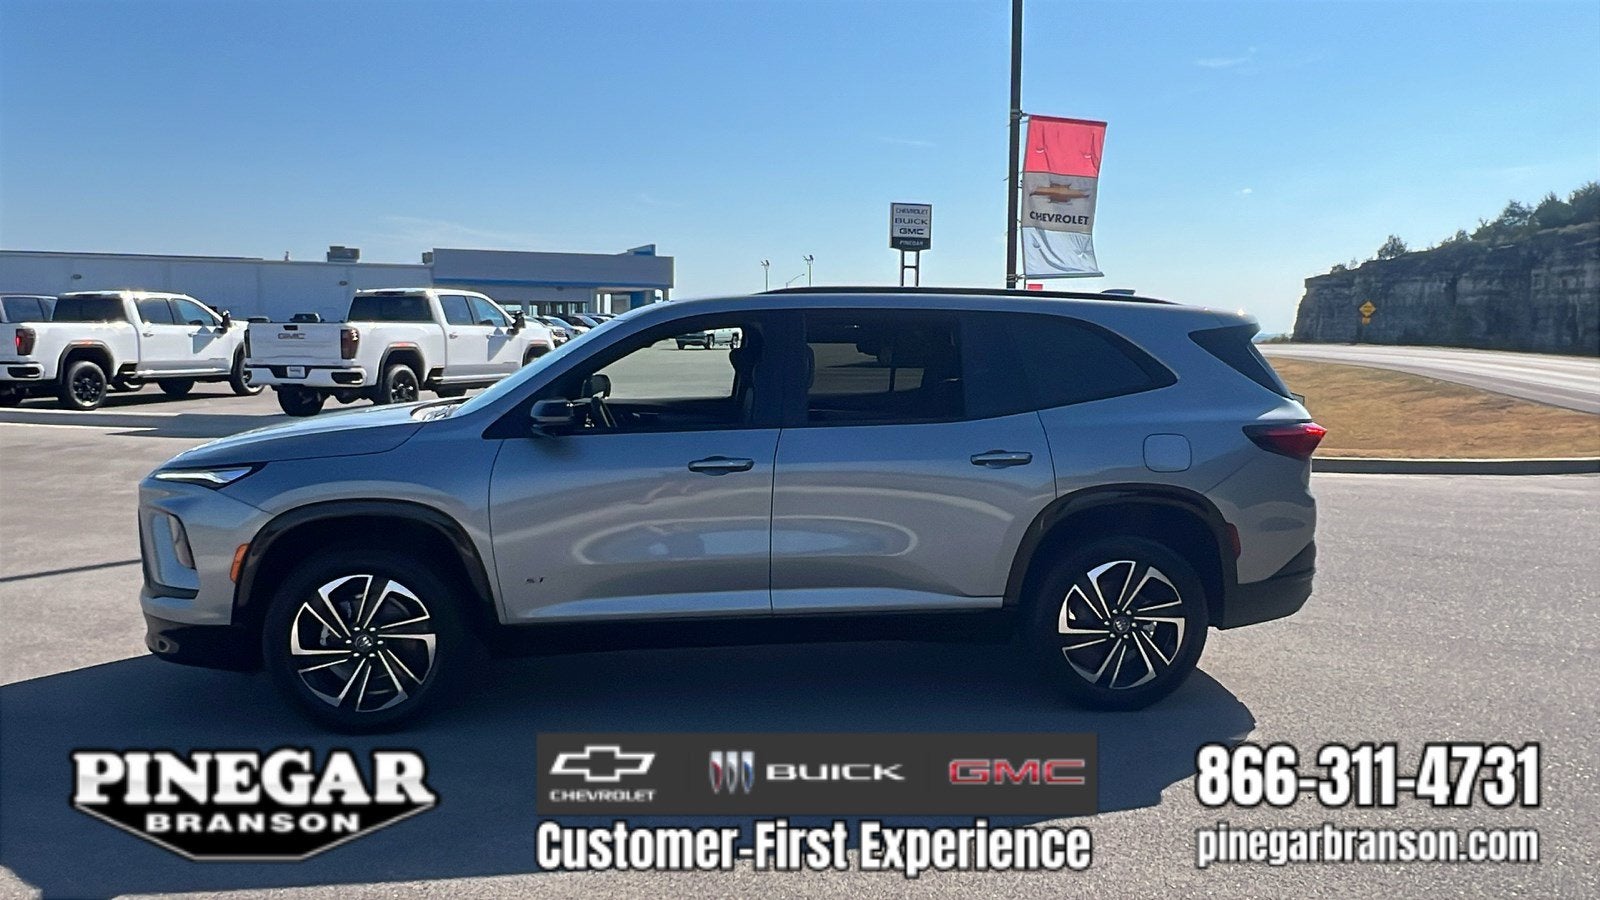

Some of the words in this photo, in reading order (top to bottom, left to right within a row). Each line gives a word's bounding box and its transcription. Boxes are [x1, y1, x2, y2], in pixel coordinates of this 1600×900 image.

[894, 217, 928, 225] BUICK
[1029, 210, 1089, 226] CHEVROLET
[899, 227, 924, 235] GMC
